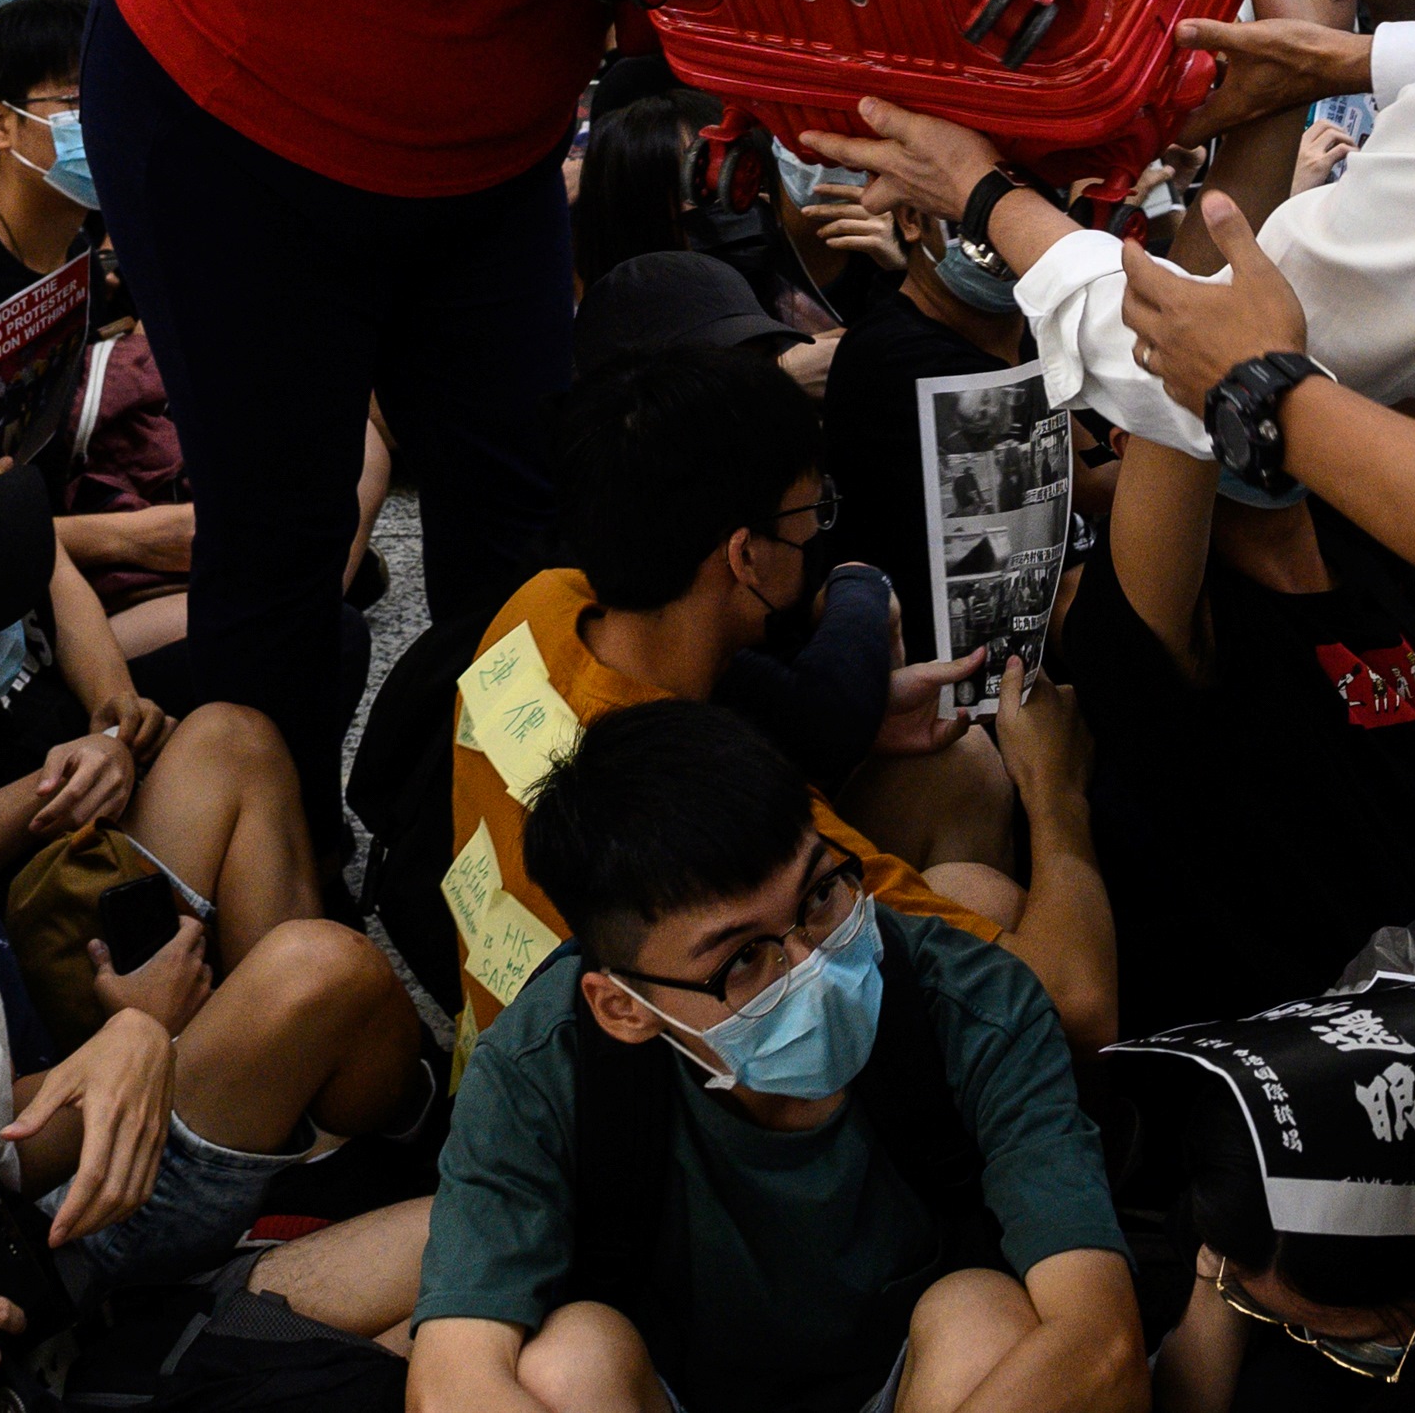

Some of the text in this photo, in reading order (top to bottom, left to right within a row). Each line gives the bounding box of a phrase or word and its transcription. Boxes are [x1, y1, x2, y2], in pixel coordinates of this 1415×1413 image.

[6, 279, 78, 335] PROTESTER
[31, 278, 58, 304] THE
[24, 304, 68, 341] WITHIN
[503, 923, 533, 964] HK
